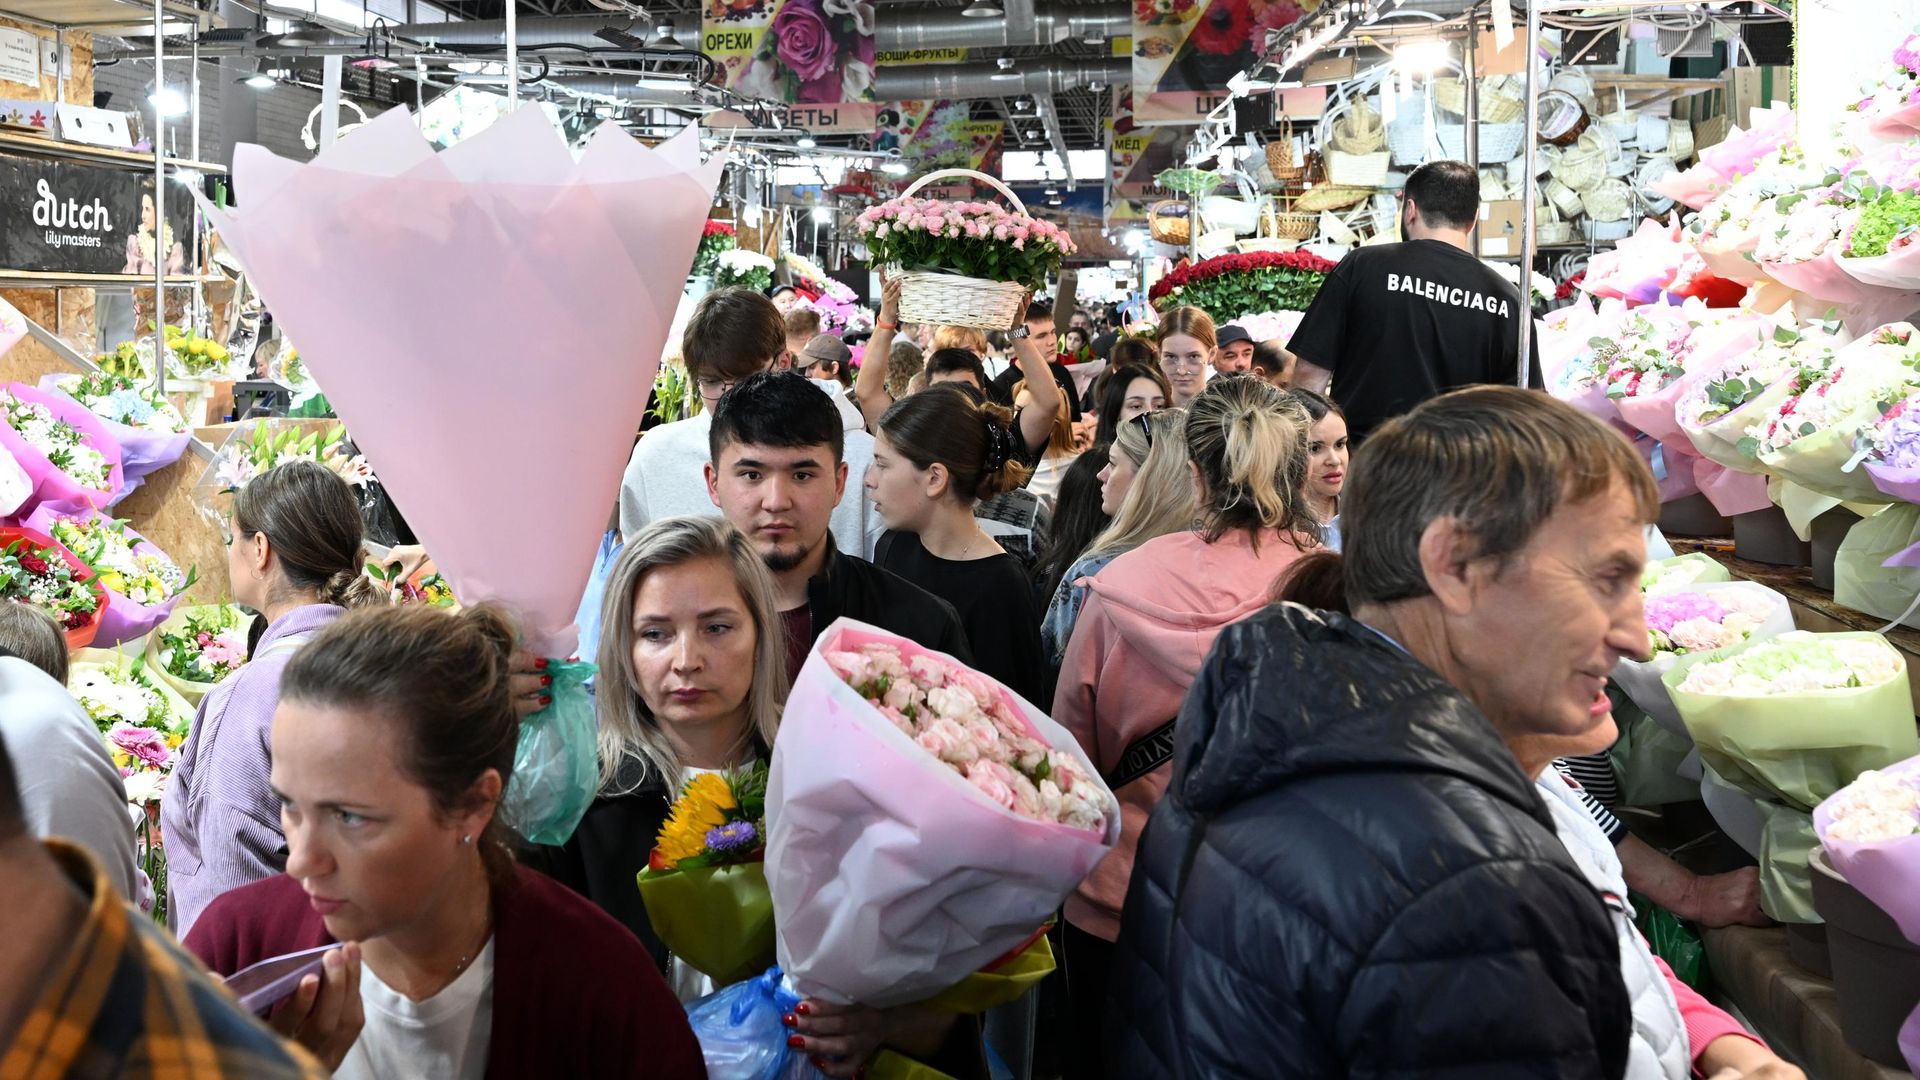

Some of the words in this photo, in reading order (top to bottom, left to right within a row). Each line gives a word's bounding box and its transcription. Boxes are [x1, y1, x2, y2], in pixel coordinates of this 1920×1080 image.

[706, 33, 753, 51] ОРЕХИ
[873, 48, 959, 61] ВОЩИ-ФРУКТЫ
[32, 178, 113, 232] dutch
[45, 230, 61, 249] lily
[62, 234, 102, 248] masters
[1387, 273, 1509, 319] BALENCIAGA
